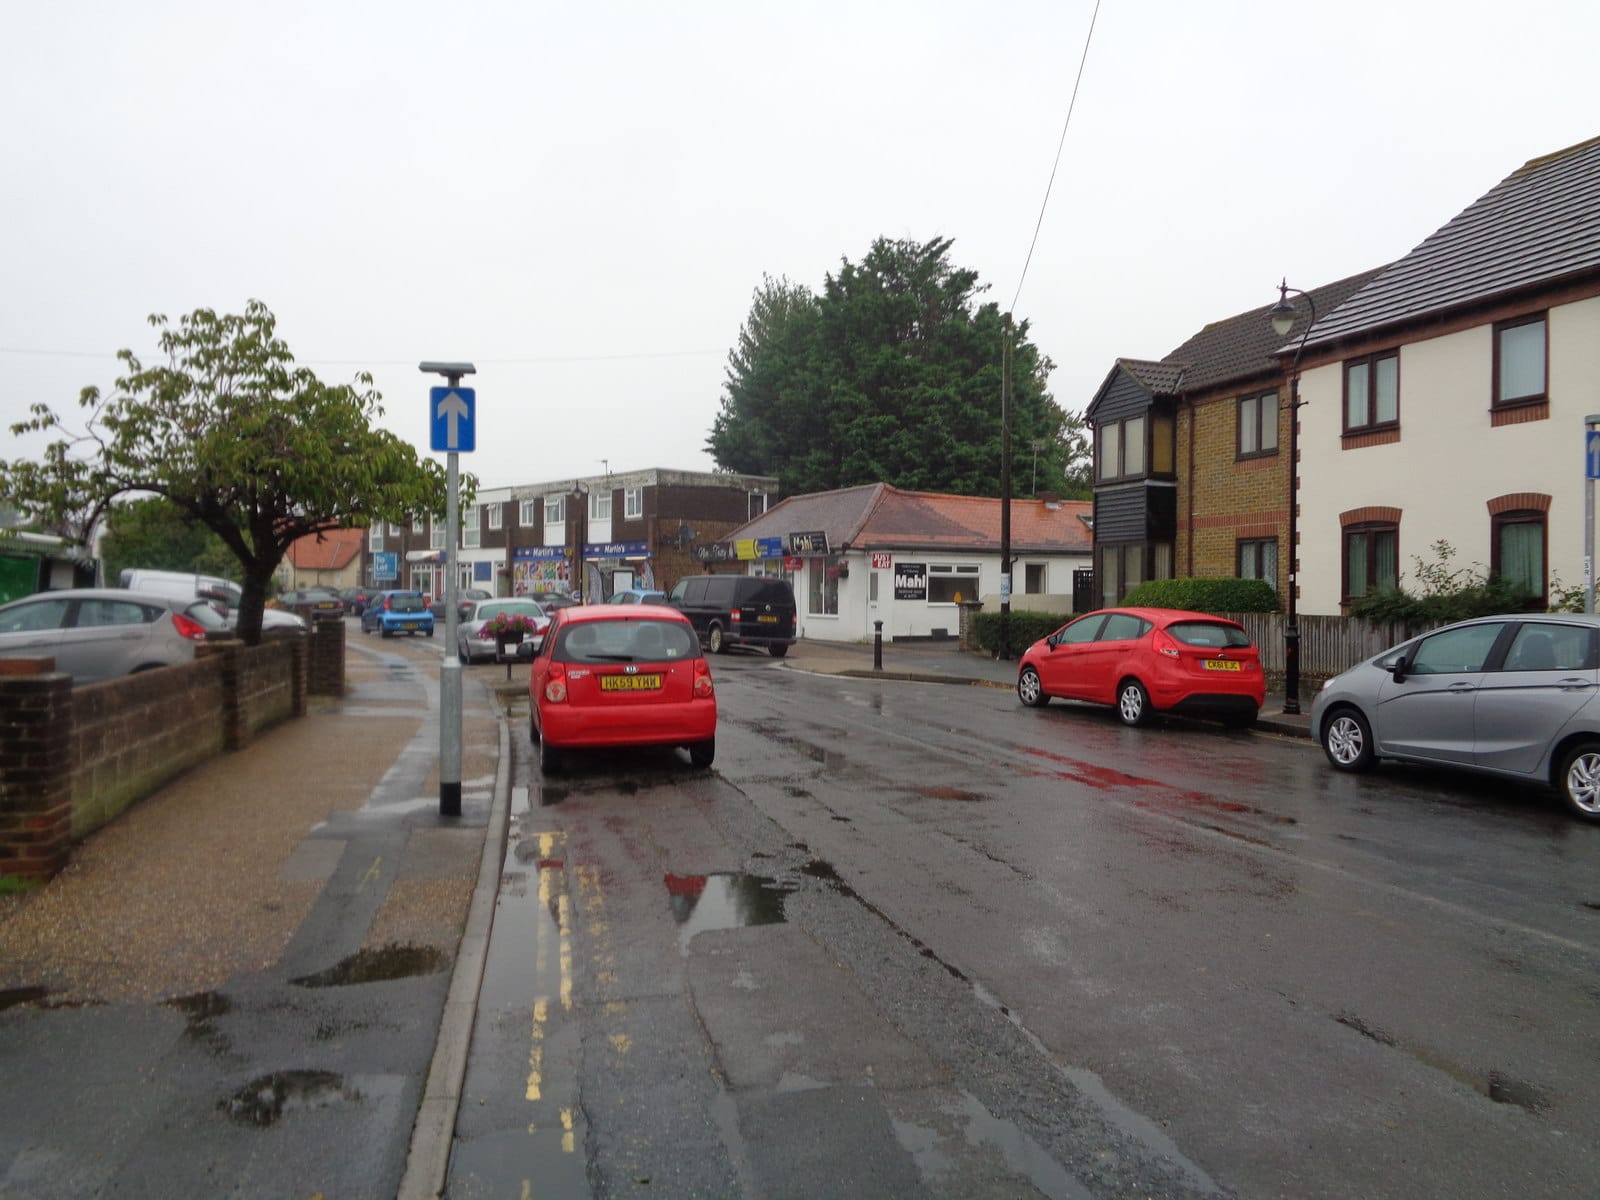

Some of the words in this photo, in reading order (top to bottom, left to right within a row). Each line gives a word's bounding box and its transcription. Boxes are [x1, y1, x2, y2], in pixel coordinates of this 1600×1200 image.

[874, 553, 889, 561] JUST
[877, 560, 890, 568] EAT
[625, 665, 638, 673] KIA
